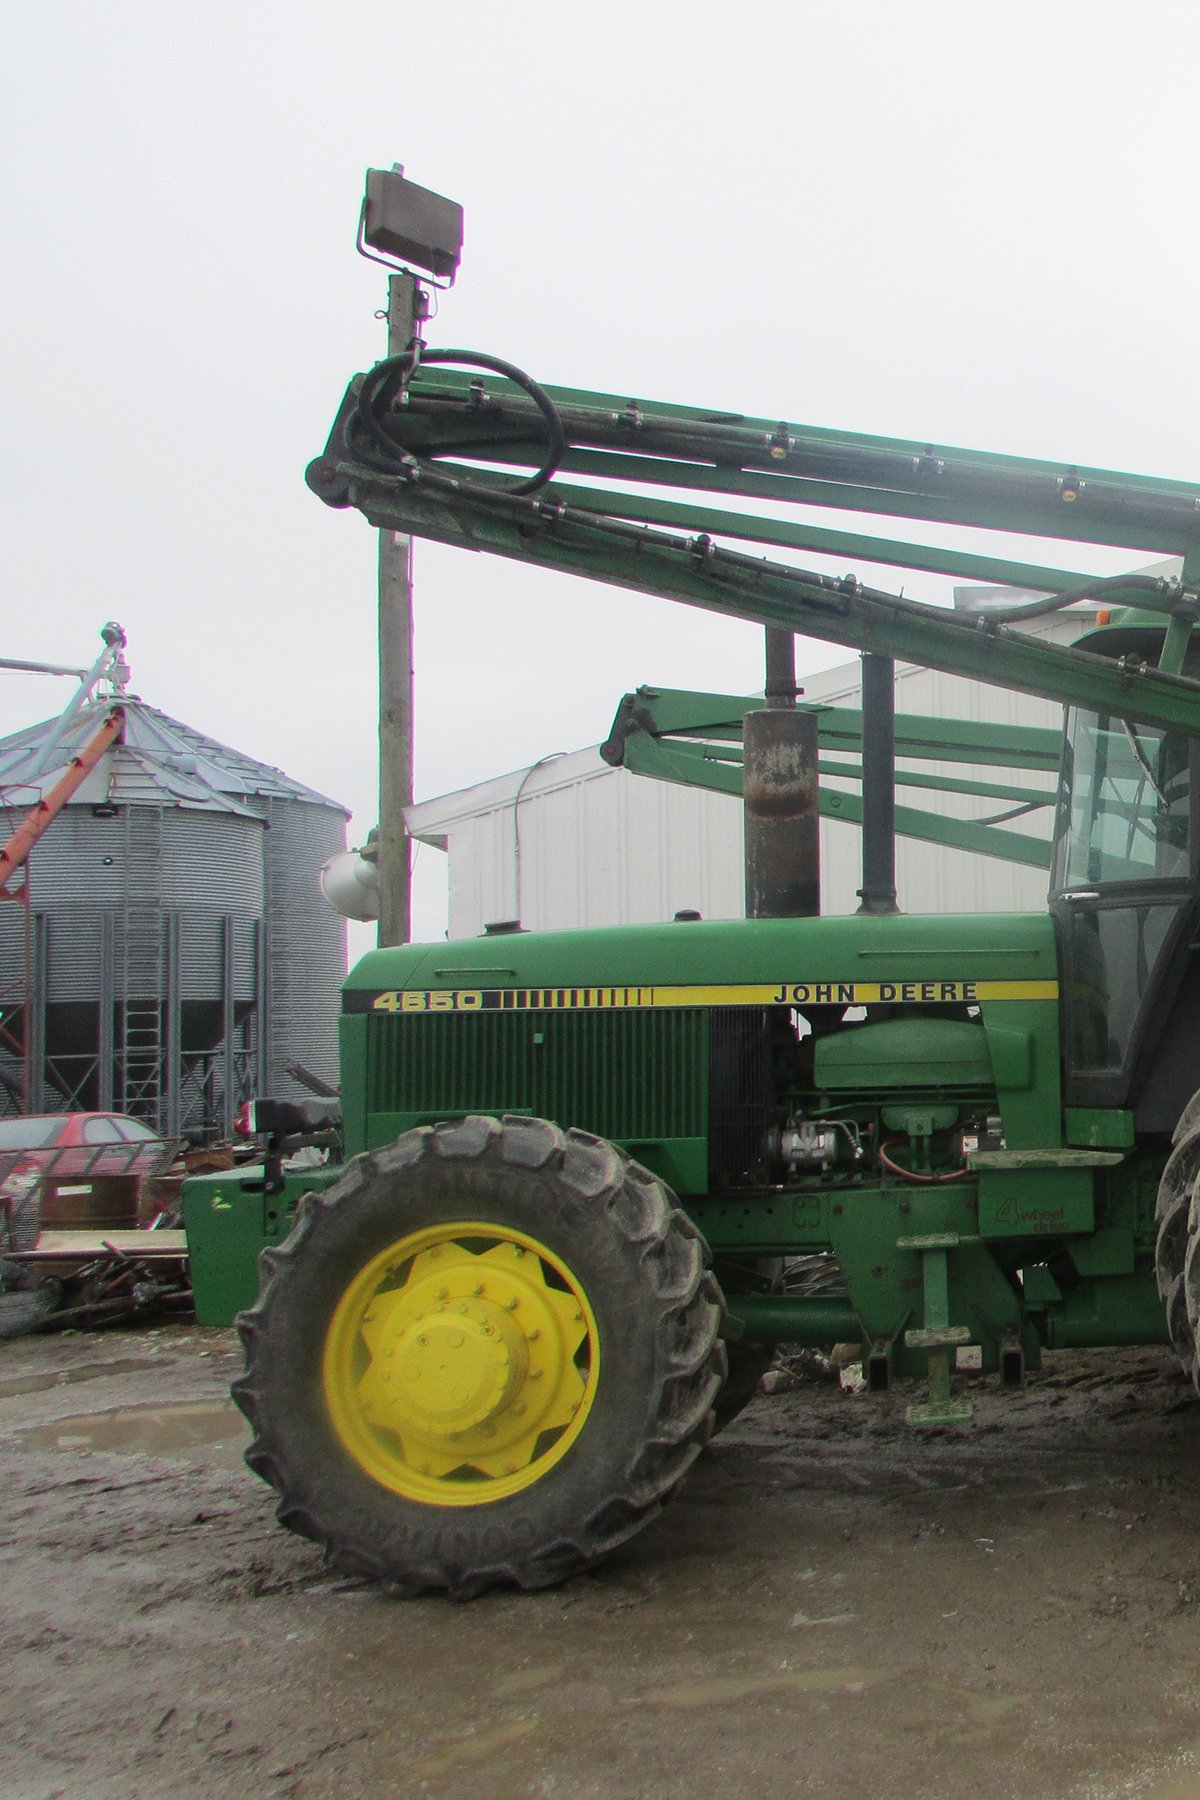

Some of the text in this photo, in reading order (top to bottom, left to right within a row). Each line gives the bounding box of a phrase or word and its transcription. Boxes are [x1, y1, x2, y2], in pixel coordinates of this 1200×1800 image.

[373, 990, 483, 1012] 4650
[774, 982, 977, 1003] JOHN DEERE
[995, 1198, 1064, 1226] 4 wheel
[1034, 1221, 1070, 1232] drive
